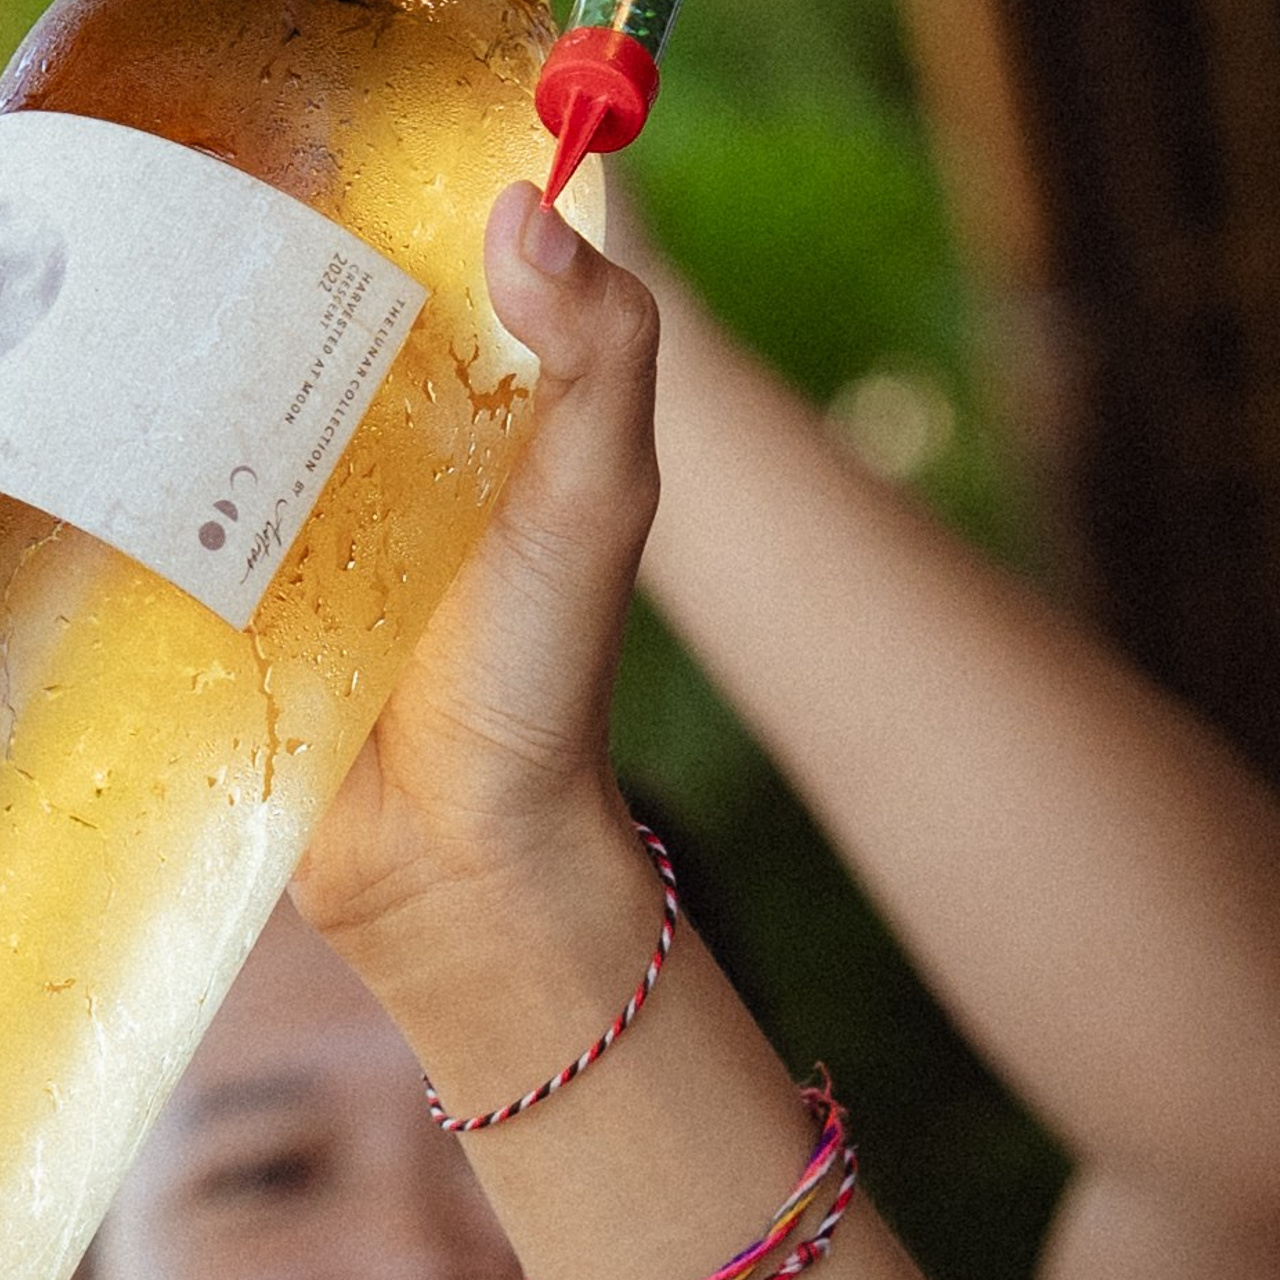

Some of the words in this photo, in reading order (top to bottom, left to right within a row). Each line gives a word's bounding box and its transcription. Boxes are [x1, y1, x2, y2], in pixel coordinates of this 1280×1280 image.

[320, 252, 348, 293] 2022
[320, 264, 360, 330] CRESCENT
[323, 271, 373, 355] HARVESTED
[384, 298, 406, 328] THE
[311, 358, 325, 380] AT
[356, 328, 388, 378] LUNAR
[284, 380, 314, 425] MOON
[305, 379, 360, 472] COLLECTION
[292, 480, 305, 497] BY
